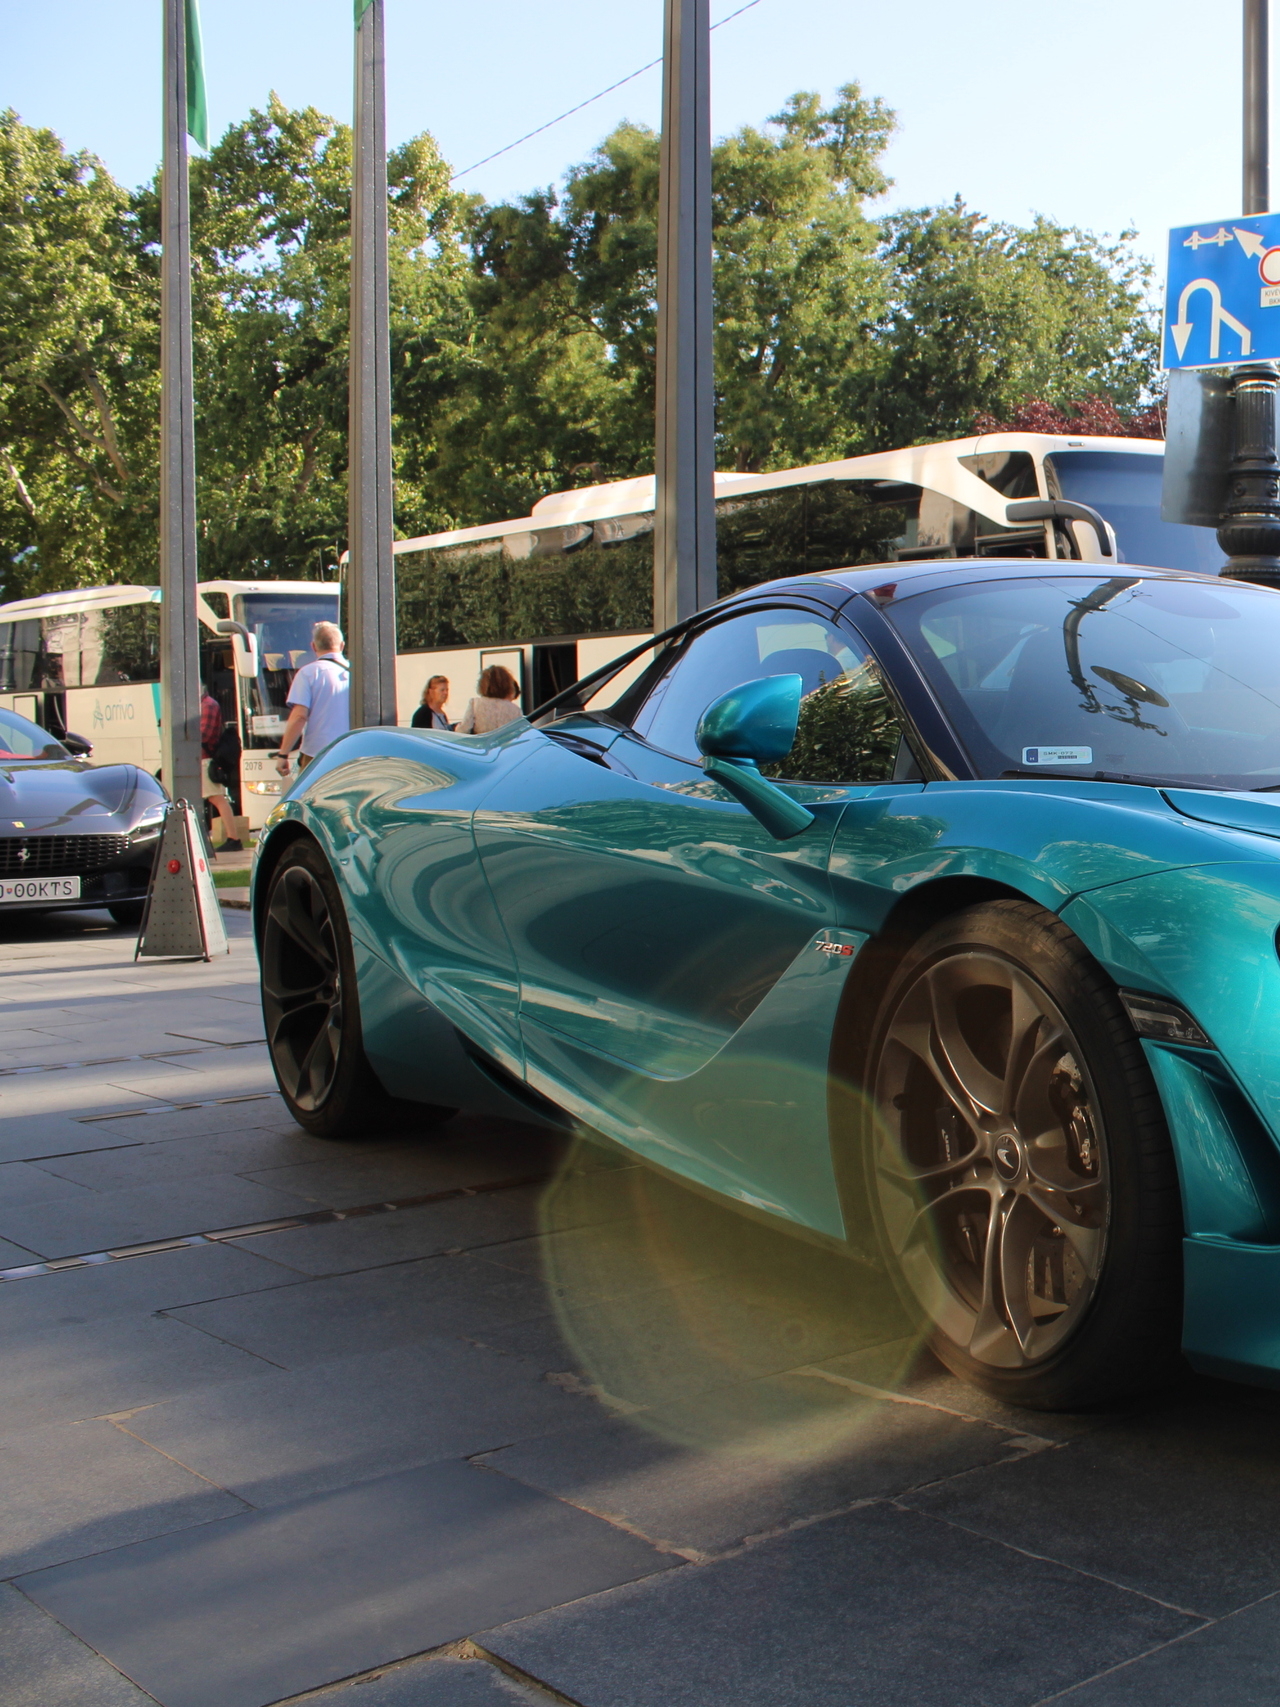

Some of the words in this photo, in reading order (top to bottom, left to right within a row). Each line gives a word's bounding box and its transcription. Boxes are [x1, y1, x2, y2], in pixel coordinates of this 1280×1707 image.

[104, 699, 134, 721] arriva
[244, 761, 263, 771] 2078
[814, 940, 855, 956] 720S
